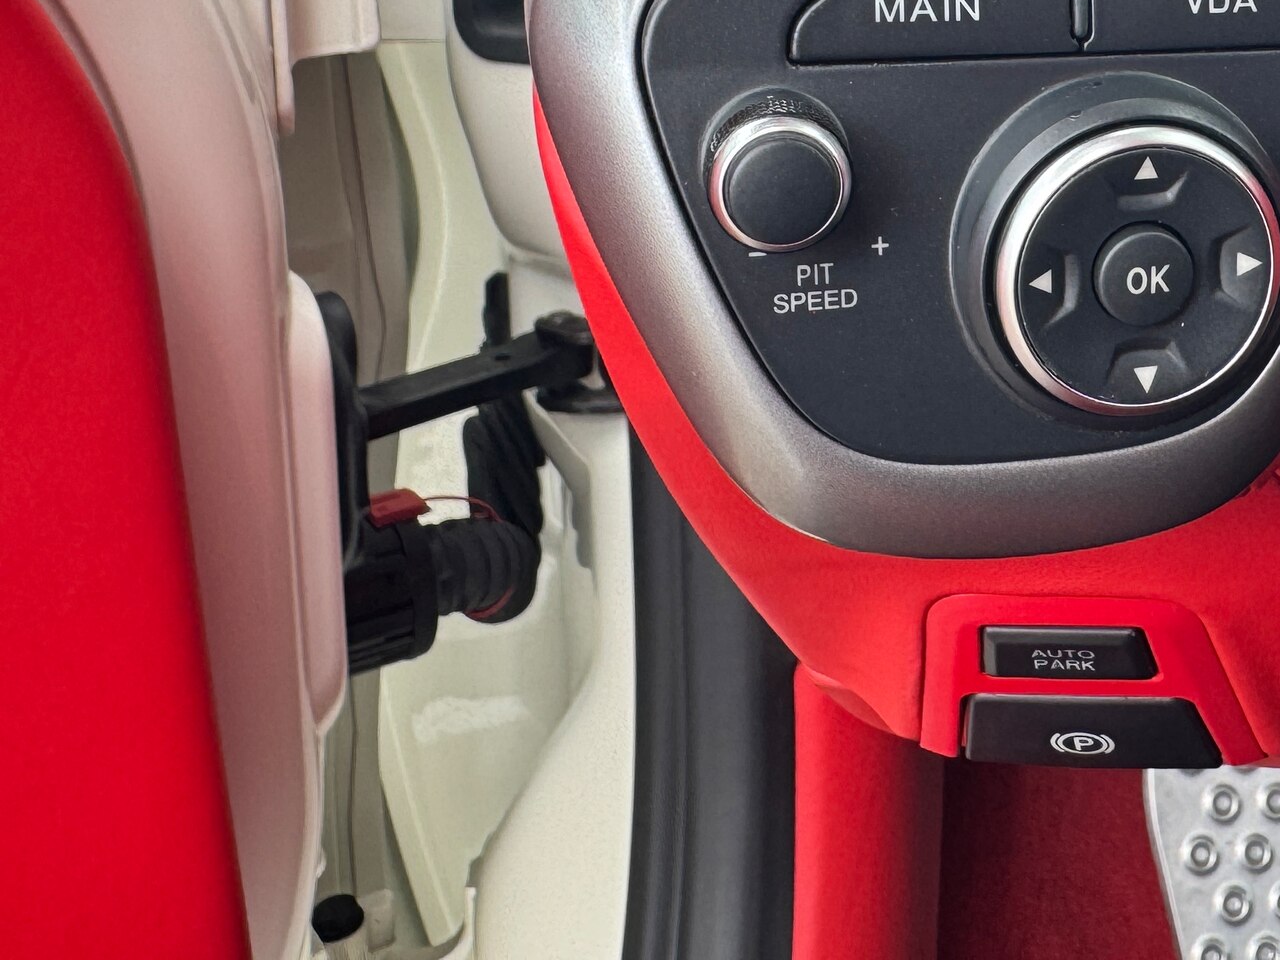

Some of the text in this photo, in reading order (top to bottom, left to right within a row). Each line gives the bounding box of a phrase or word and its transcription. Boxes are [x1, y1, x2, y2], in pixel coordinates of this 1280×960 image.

[796, 262, 834, 287] PIT
[1126, 264, 1170, 296] OK
[773, 288, 858, 314] SPEED
[1031, 649, 1096, 659] AUTO
[1033, 659, 1096, 671] PARK
